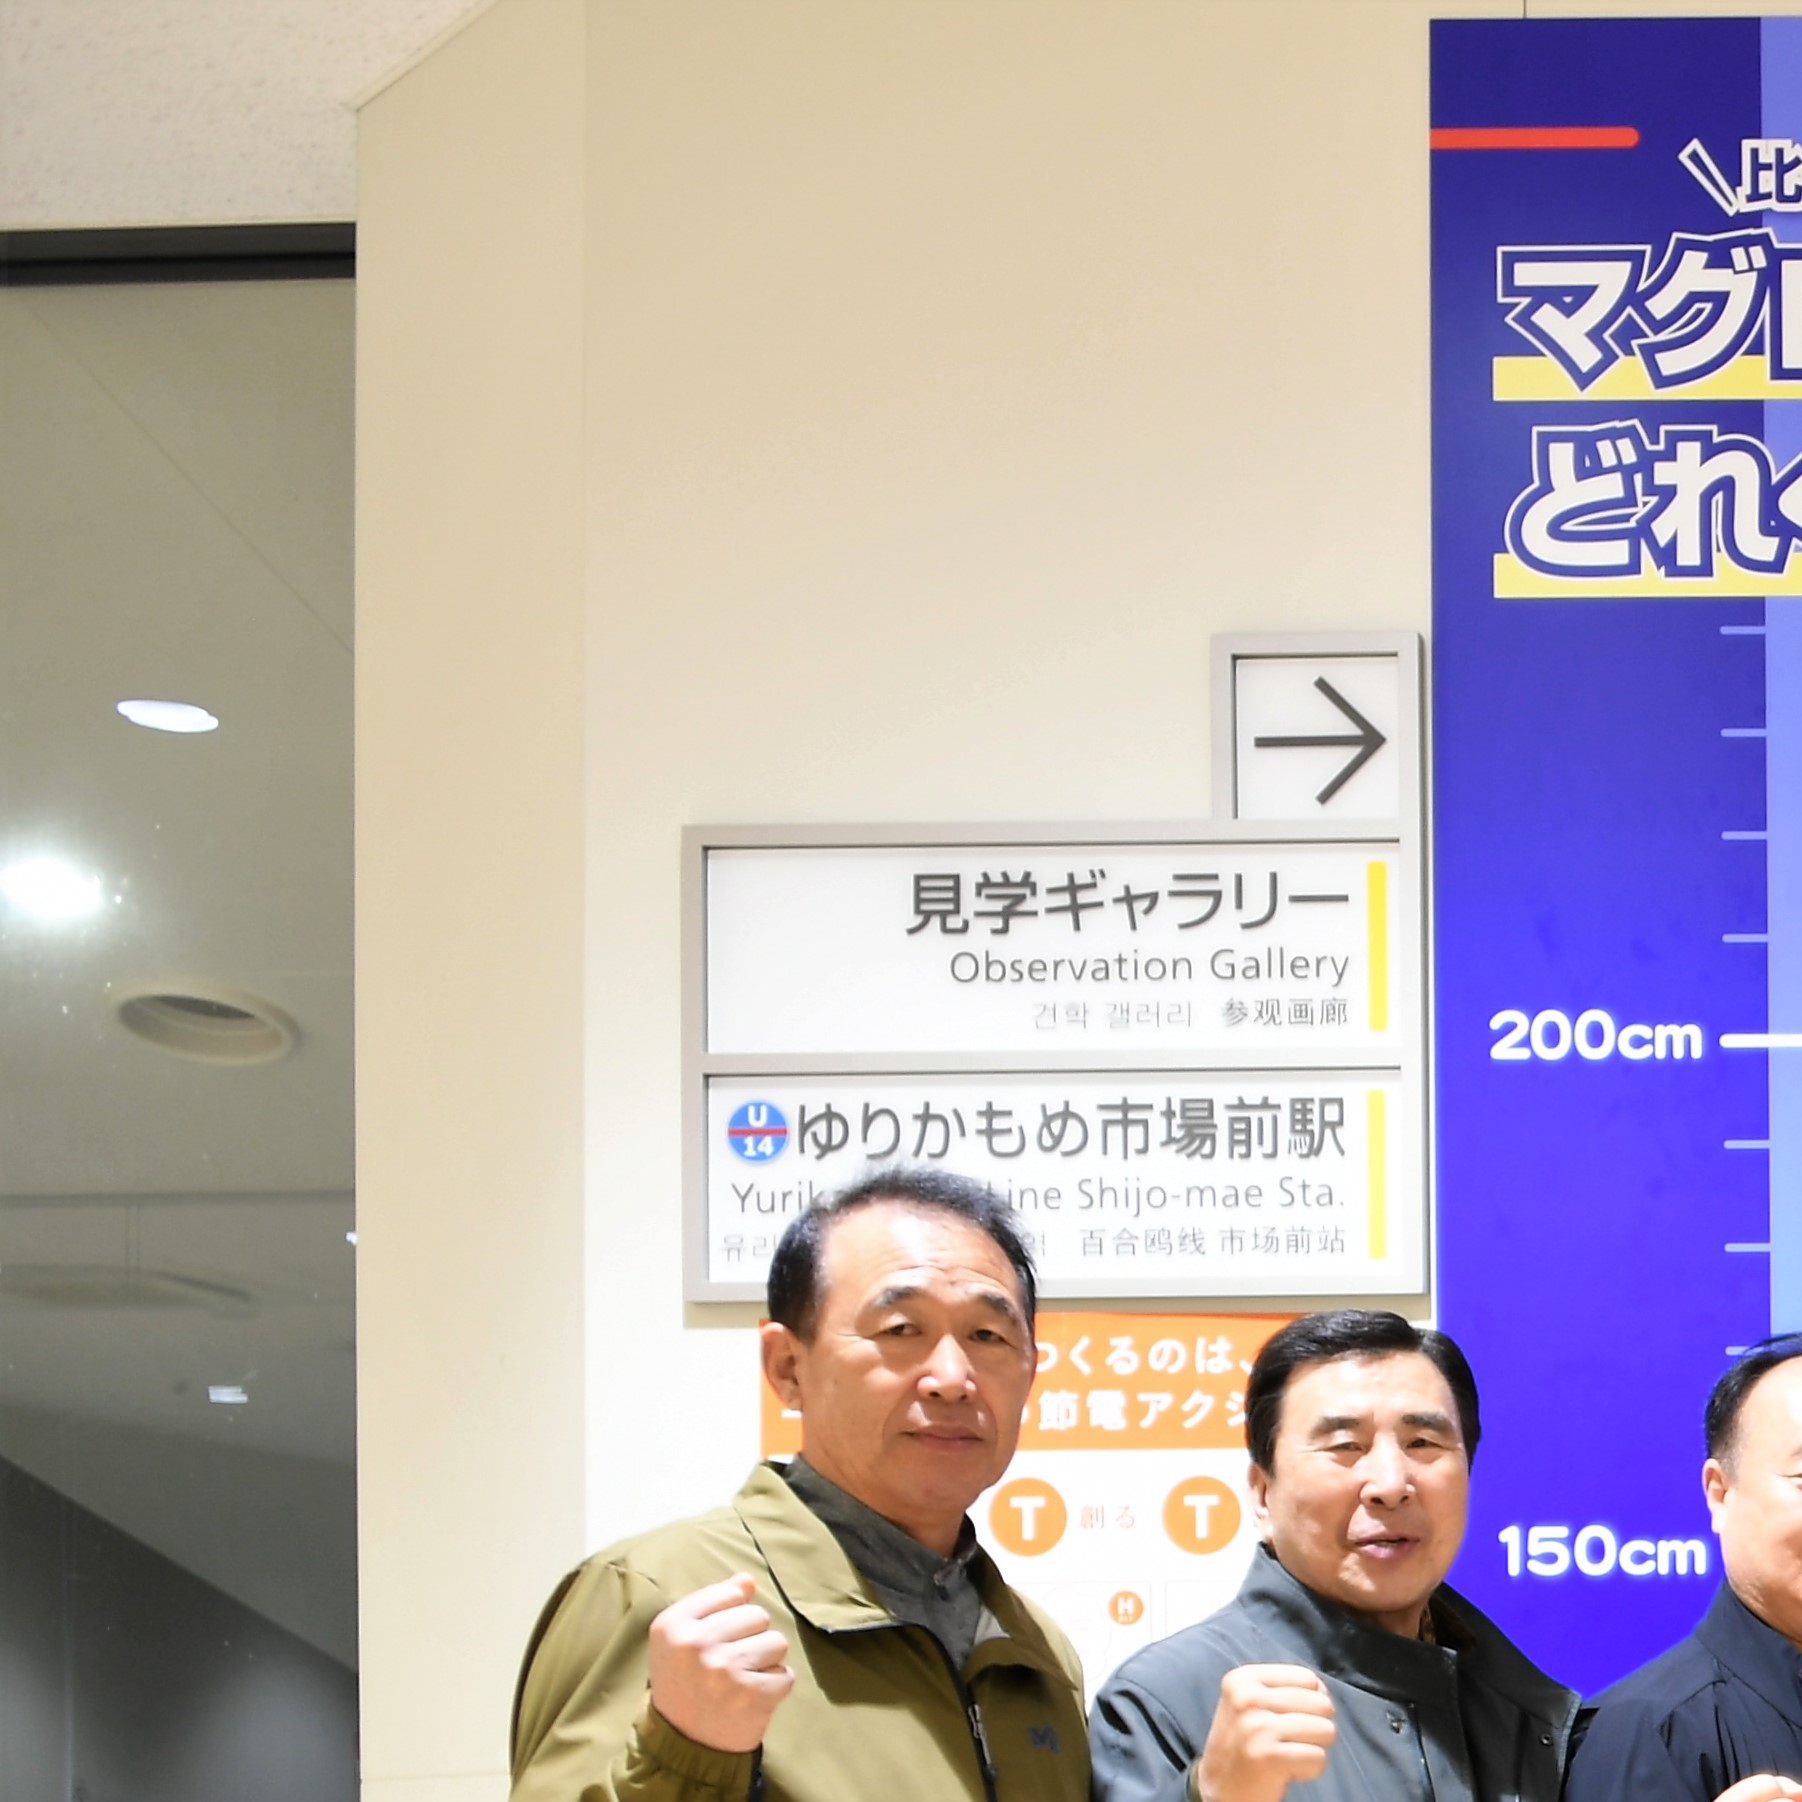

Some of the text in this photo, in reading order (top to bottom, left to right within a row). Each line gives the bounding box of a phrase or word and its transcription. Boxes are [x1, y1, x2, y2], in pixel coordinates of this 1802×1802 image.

[905, 868, 1350, 936] 見学ギャラリー
[950, 946, 1350, 987] Observation Gallery
[1222, 998, 1348, 1027] 参观画廊
[1489, 1009, 1702, 1061] 200cm
[743, 1135, 774, 1157] 14
[797, 1096, 1346, 1160] ゆりかもめ市場前駅
[1077, 1178, 1264, 1218] Shijo-mae
[1279, 1177, 1345, 1208] Sta.
[1020, 1389, 1248, 1431] 節電アクシ
[1499, 1525, 1707, 1577] 150cm
